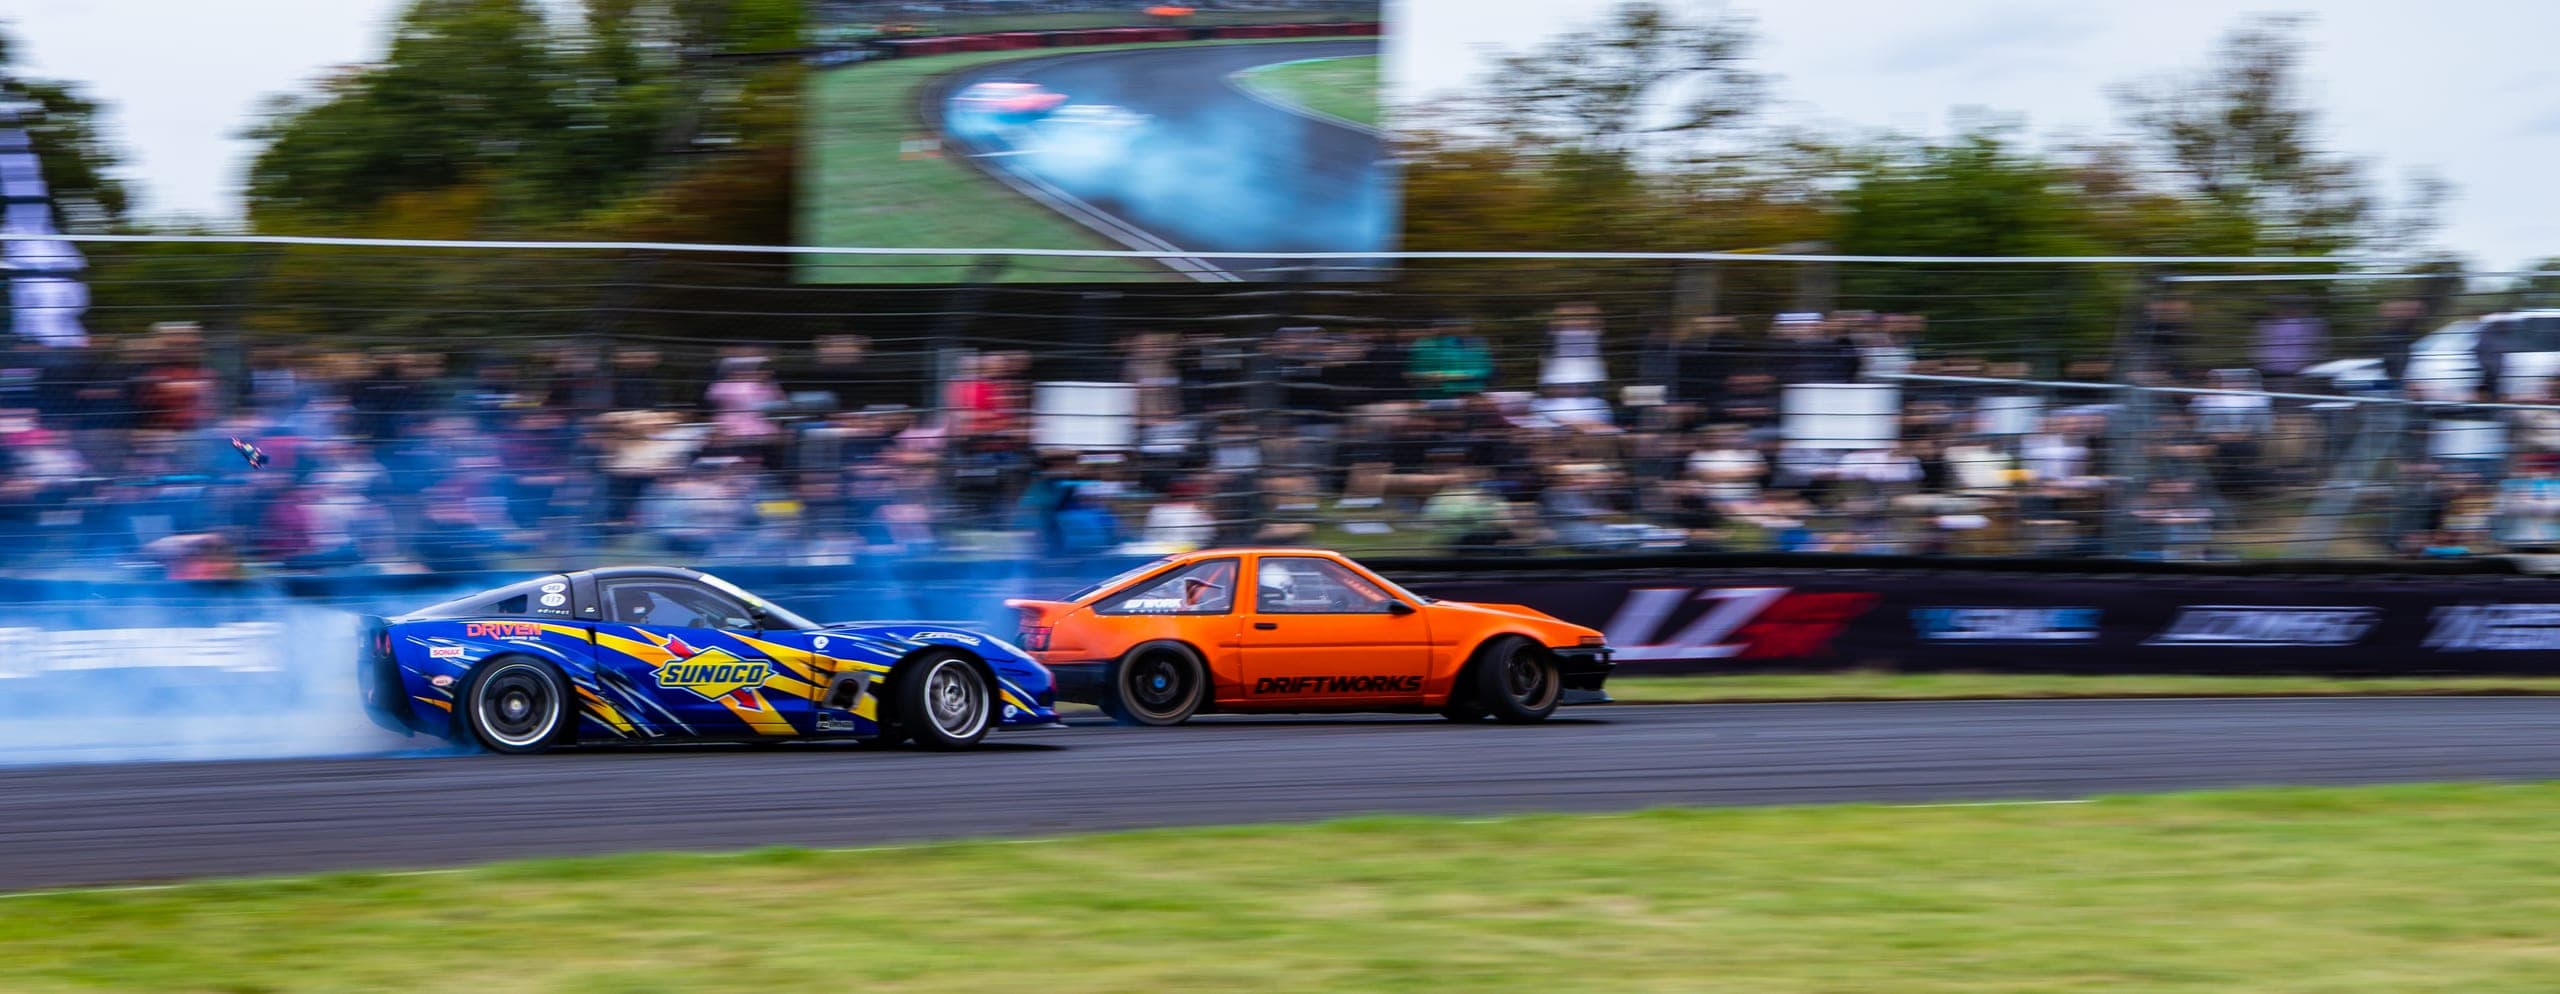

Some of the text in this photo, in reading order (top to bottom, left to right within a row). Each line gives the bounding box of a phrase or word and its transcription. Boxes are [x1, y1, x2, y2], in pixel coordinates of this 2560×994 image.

[466, 623, 542, 640] DRIVEN
[663, 665, 765, 683] SUNOCO
[1254, 675, 1424, 694] DRIFTWORKS
